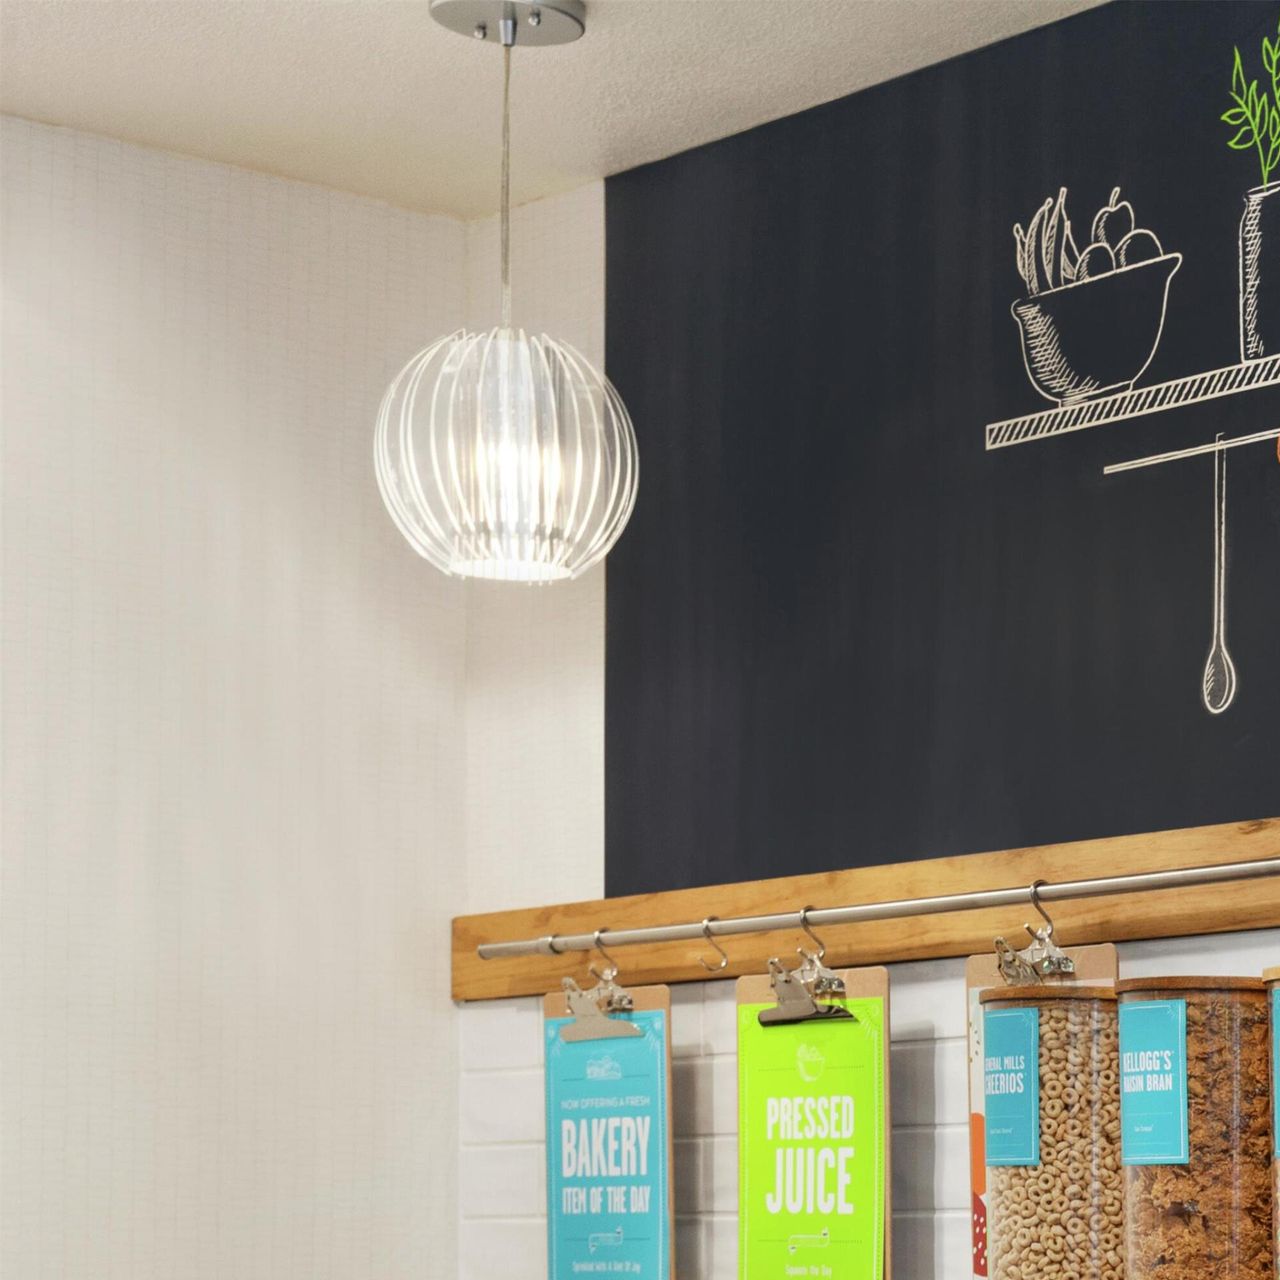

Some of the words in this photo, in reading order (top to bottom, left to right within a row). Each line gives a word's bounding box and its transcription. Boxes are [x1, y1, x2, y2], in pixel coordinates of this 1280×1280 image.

[1003, 1055, 1025, 1070] MILLS
[1146, 1073, 1173, 1091] BRAN
[766, 1095, 855, 1141] PRESSED
[561, 1115, 651, 1179] BAKERY
[562, 1186, 587, 1215] ITEM
[590, 1186, 603, 1214] OF
[605, 1186, 627, 1214] THE
[630, 1185, 650, 1214] DAY
[765, 1146, 855, 1216] JUICE
